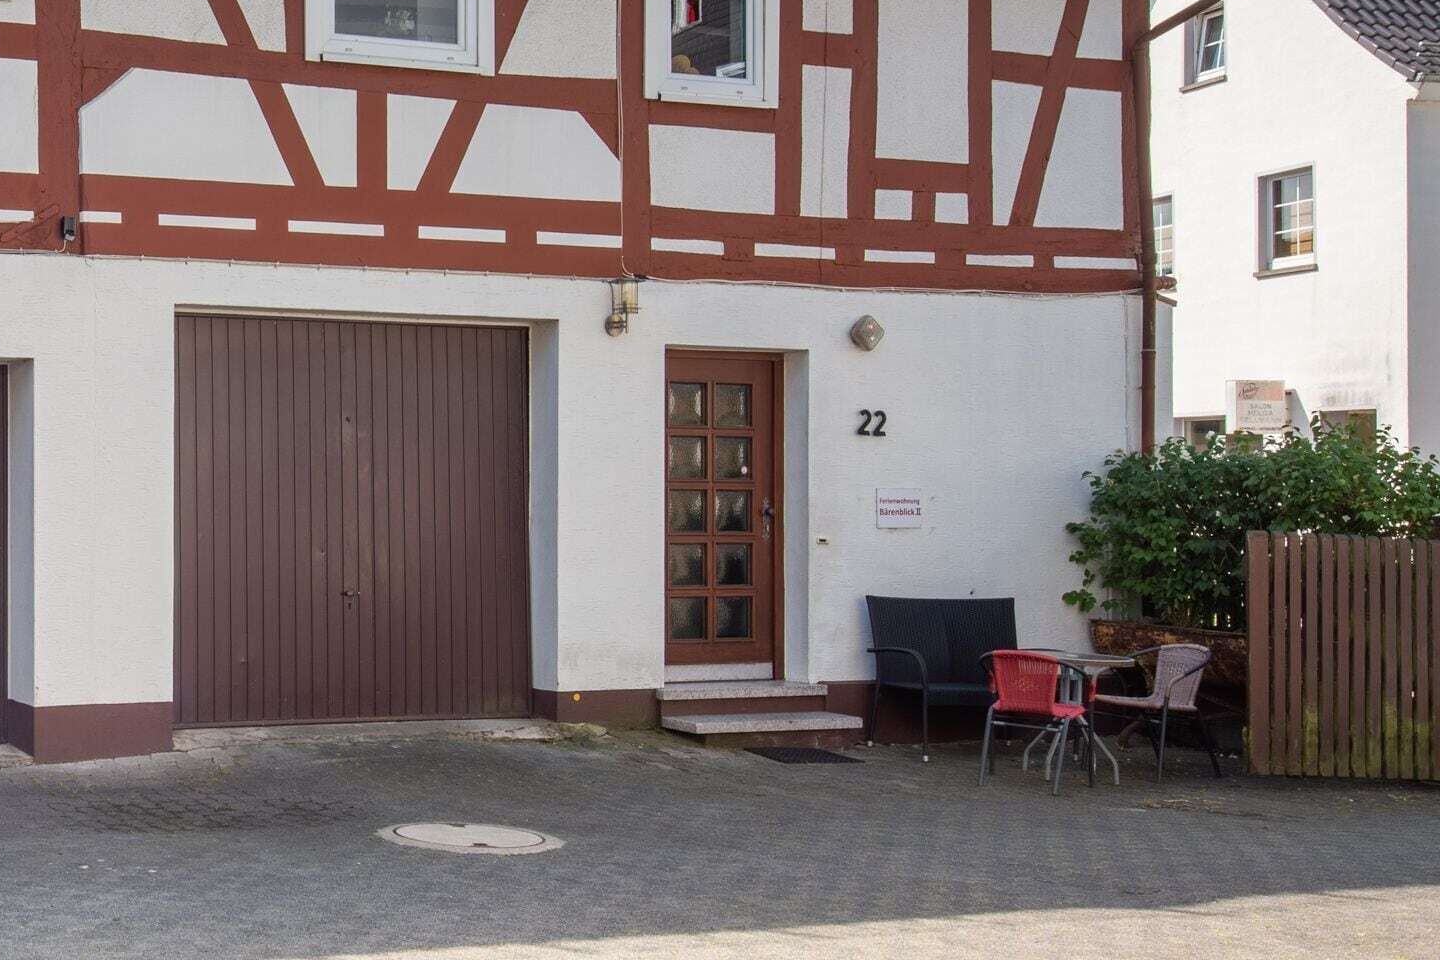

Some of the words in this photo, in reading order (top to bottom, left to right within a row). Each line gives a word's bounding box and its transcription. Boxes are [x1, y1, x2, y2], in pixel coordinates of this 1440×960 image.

[857, 409, 887, 437] 22
[879, 497, 920, 506] Ferienwohnung
[879, 507, 914, 516] Bärenblick
